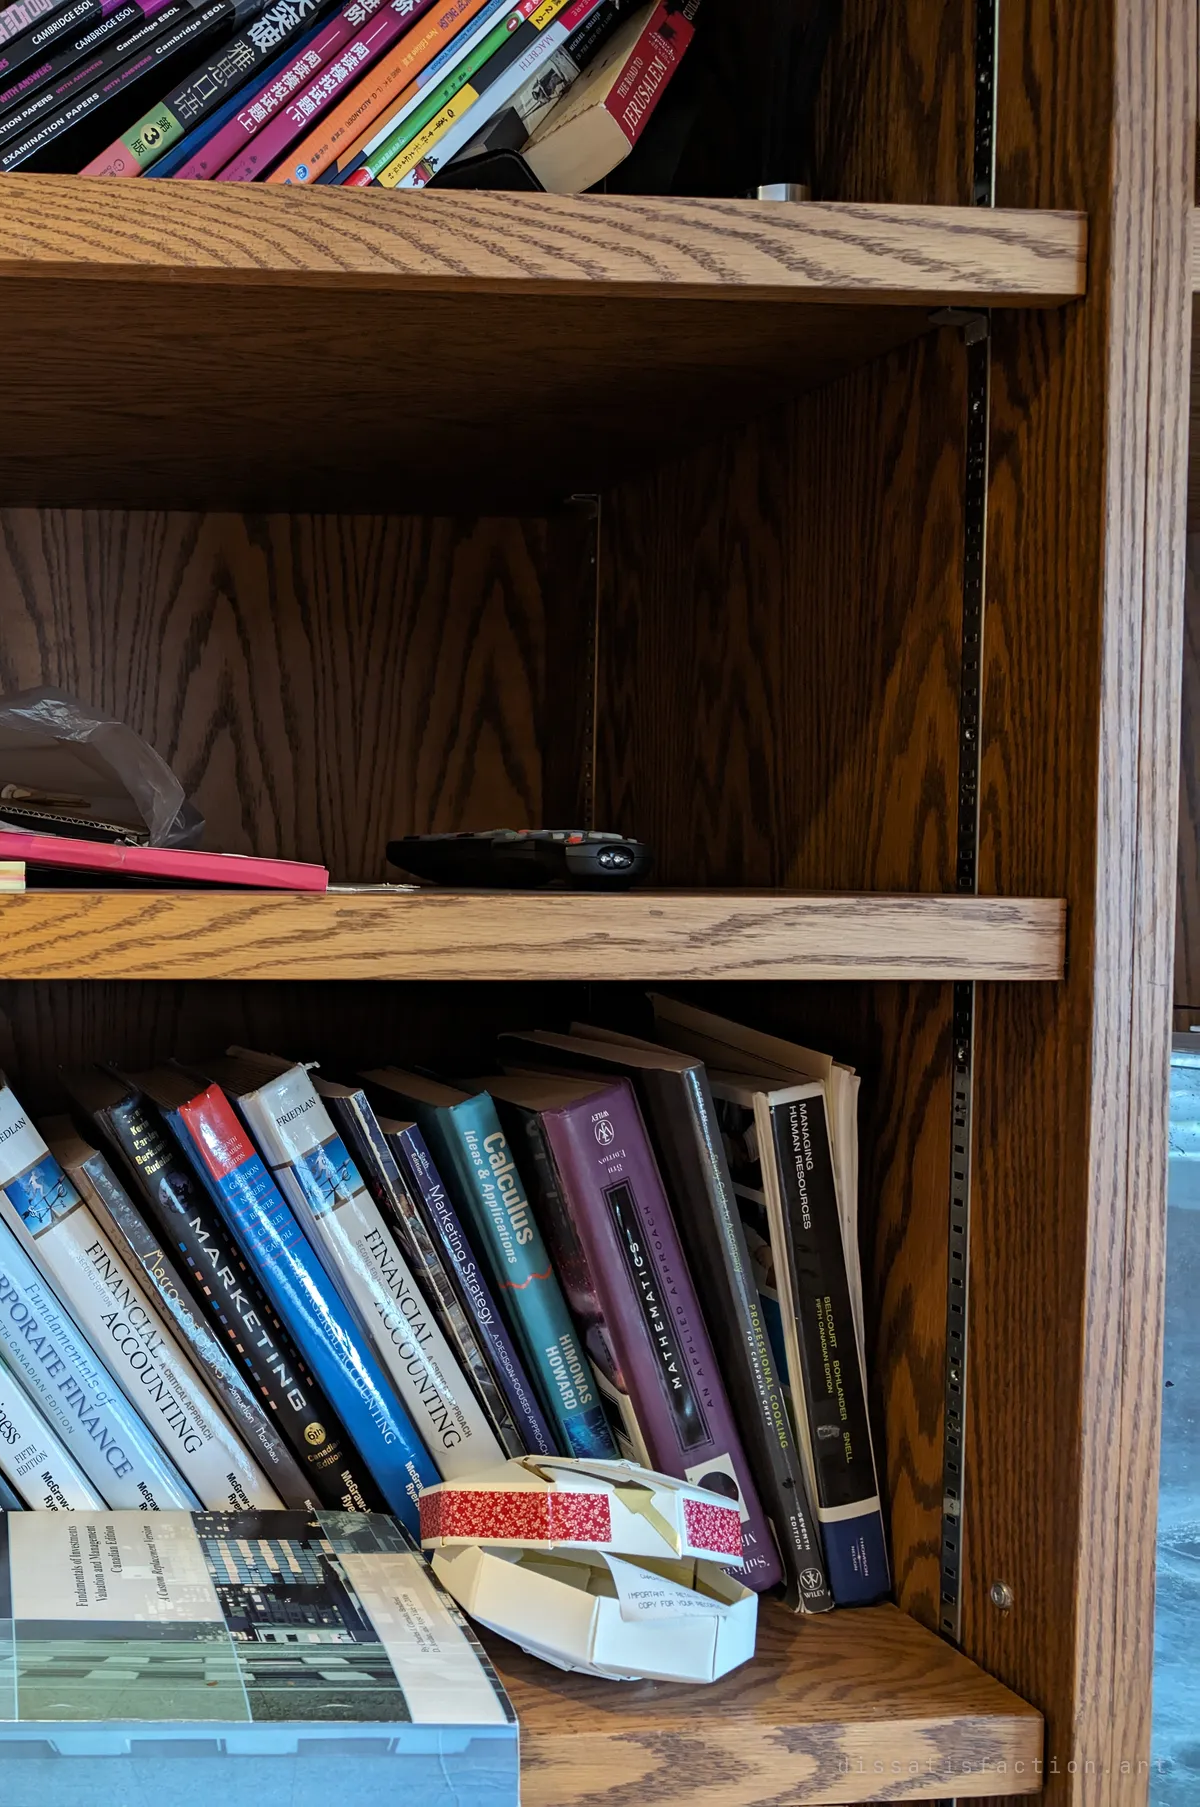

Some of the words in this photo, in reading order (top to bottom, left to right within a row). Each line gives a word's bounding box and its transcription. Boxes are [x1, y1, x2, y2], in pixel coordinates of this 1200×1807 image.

[30, 12, 73, 46] CAMBRIDGE
[69, 0, 93, 18] ESOL
[73, 17, 116, 52] CAMBRIDGE
[113, 5, 134, 23] ESOL
[114, 20, 159, 54] Cambridge
[156, 4, 180, 23] ESOL
[152, 19, 202, 56] Cambridge
[200, 1, 226, 20] ESOL
[435, 6, 460, 30] ENGLISH
[410, 38, 429, 55] Edition
[517, 34, 554, 71] MACBETH
[631, 55, 644, 68] TO
[16, 61, 53, 91] ANSWERS
[173, 38, 255, 119] 雅思口语
[615, 81, 630, 98] THE
[621, 55, 667, 136] JERUSALEM
[622, 65, 639, 85] ROAD
[0, 116, 67, 165] EXAMINATION
[63, 91, 101, 119] PAPERS
[19, 92, 55, 119] PAPERS
[274, 1093, 318, 1129] FRIEDLAN
[591, 1110, 609, 1122] WILEY
[787, 1104, 802, 1152] HUMAN
[797, 1103, 815, 1170] MANAGING
[463, 1129, 485, 1167] Ideas
[478, 1180, 519, 1266] Applications
[479, 1128, 540, 1248] Calculus
[793, 1155, 813, 1230] RESOURCES
[423, 1184, 473, 1263] Marketing
[455, 1262, 501, 1328] Strategy
[643, 1204, 676, 1302] APPROACH
[721, 1220, 745, 1274] Accompany
[79, 1239, 172, 1359] FINANCIAL
[354, 1227, 445, 1352] FINANCIAL
[813, 1297, 824, 1320] FIFTH
[15, 1280, 109, 1390] Fundamentals
[183, 1216, 310, 1413] MARKETING
[628, 1239, 683, 1391] MATHEMATICS
[820, 1295, 841, 1349] BELCOURT
[675, 1302, 704, 1378] APPLIED
[744, 1329, 755, 1348] FOR
[814, 1320, 831, 1362] CANADIAN
[89, 1306, 213, 1457] ACCOUNTING
[358, 1295, 476, 1451] ACCOUNTING
[540, 1344, 583, 1412] HOWARD
[554, 1333, 596, 1405] HIMONAS
[744, 1303, 777, 1390] PROFESSIONAL
[766, 1394, 790, 1449] COOKING
[748, 1351, 768, 1396] CANADIAN
[821, 1362, 835, 1394] EDITION
[830, 1360, 848, 1421] BOHLANDER
[43, 1393, 75, 1435] EDITION
[700, 1386, 715, 1408] AN
[760, 1398, 774, 1427] CHEFS
[53, 1373, 137, 1480] FINANCE
[841, 1431, 854, 1464] SNELL
[15, 1449, 49, 1477] EDITION
[789, 1516, 803, 1550] EDITION
[796, 1511, 811, 1550] SEVENTH
[854, 1536, 873, 1577] THOMSON
[628, 1590, 666, 1600] IMPORTANT
[638, 1600, 656, 1609] COPY
[661, 1600, 674, 1609] FOR
[803, 1589, 825, 1599] WILEY
